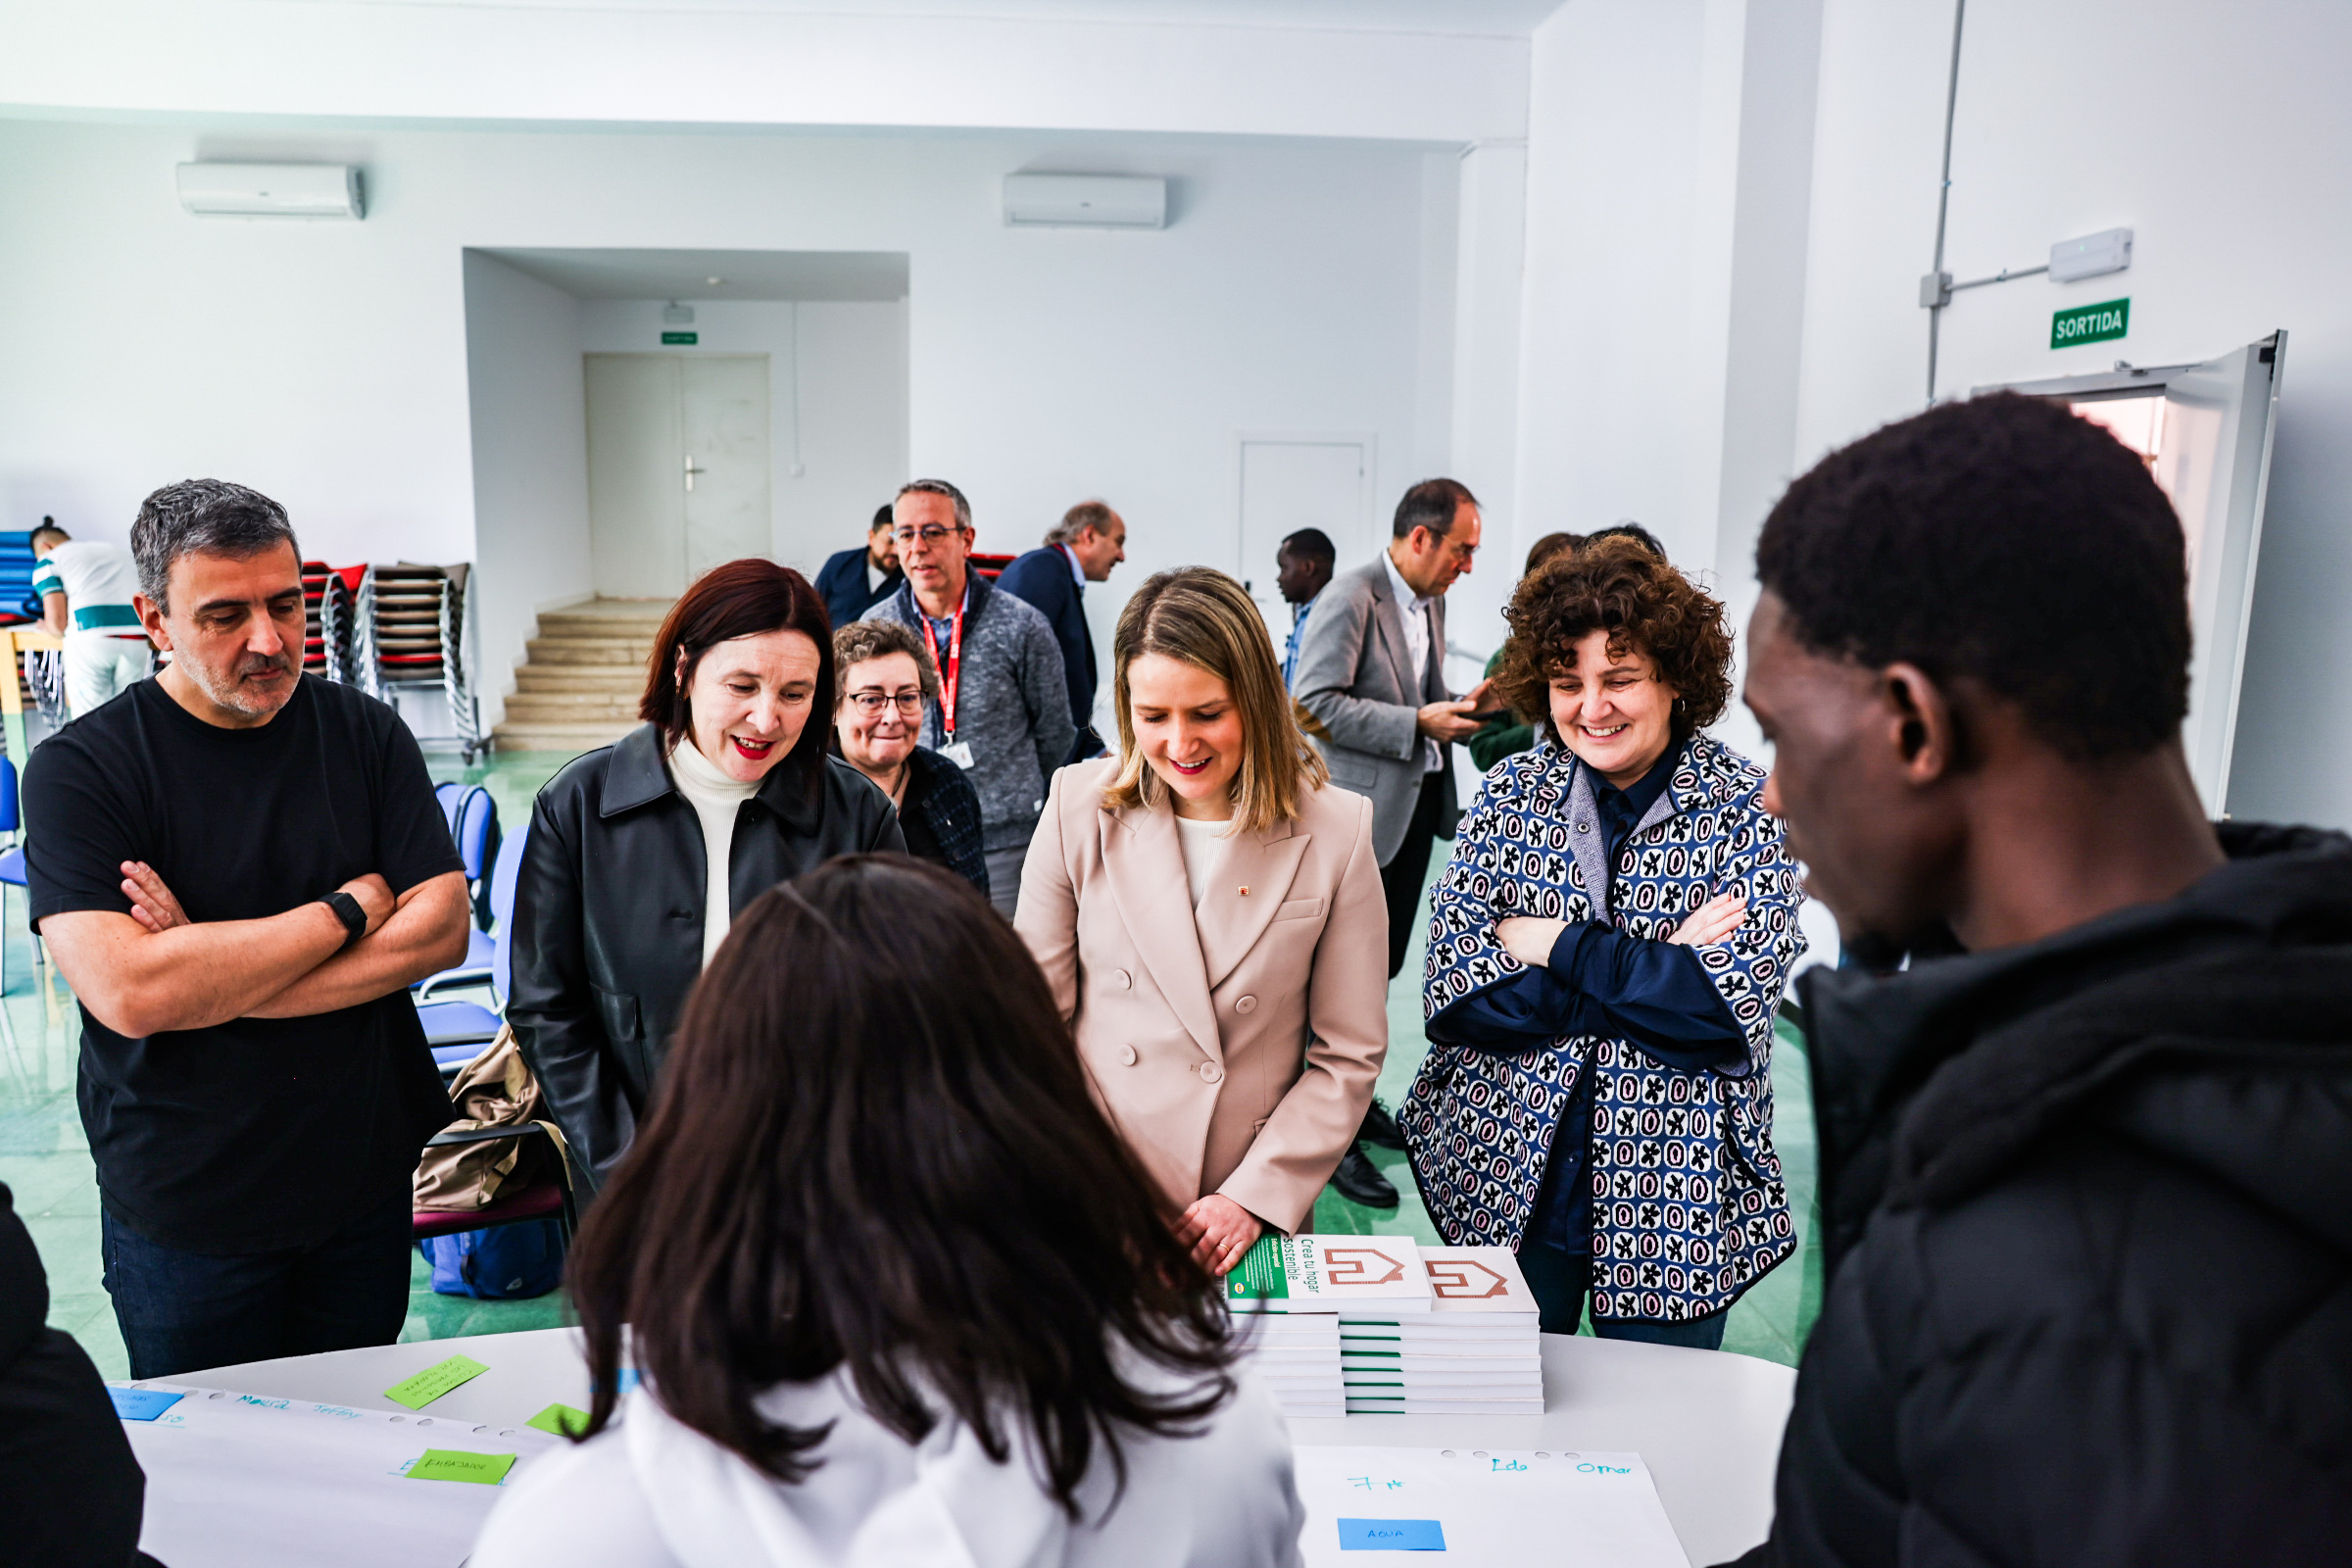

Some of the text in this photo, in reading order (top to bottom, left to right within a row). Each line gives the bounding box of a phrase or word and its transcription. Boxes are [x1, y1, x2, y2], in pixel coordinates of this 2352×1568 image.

[2056, 309, 2123, 339] SORTIDA
[1283, 1238, 1301, 1281] sostenible
[1301, 1239, 1320, 1294] Crea tu hogar
[1576, 1463, 1633, 1475] Omar
